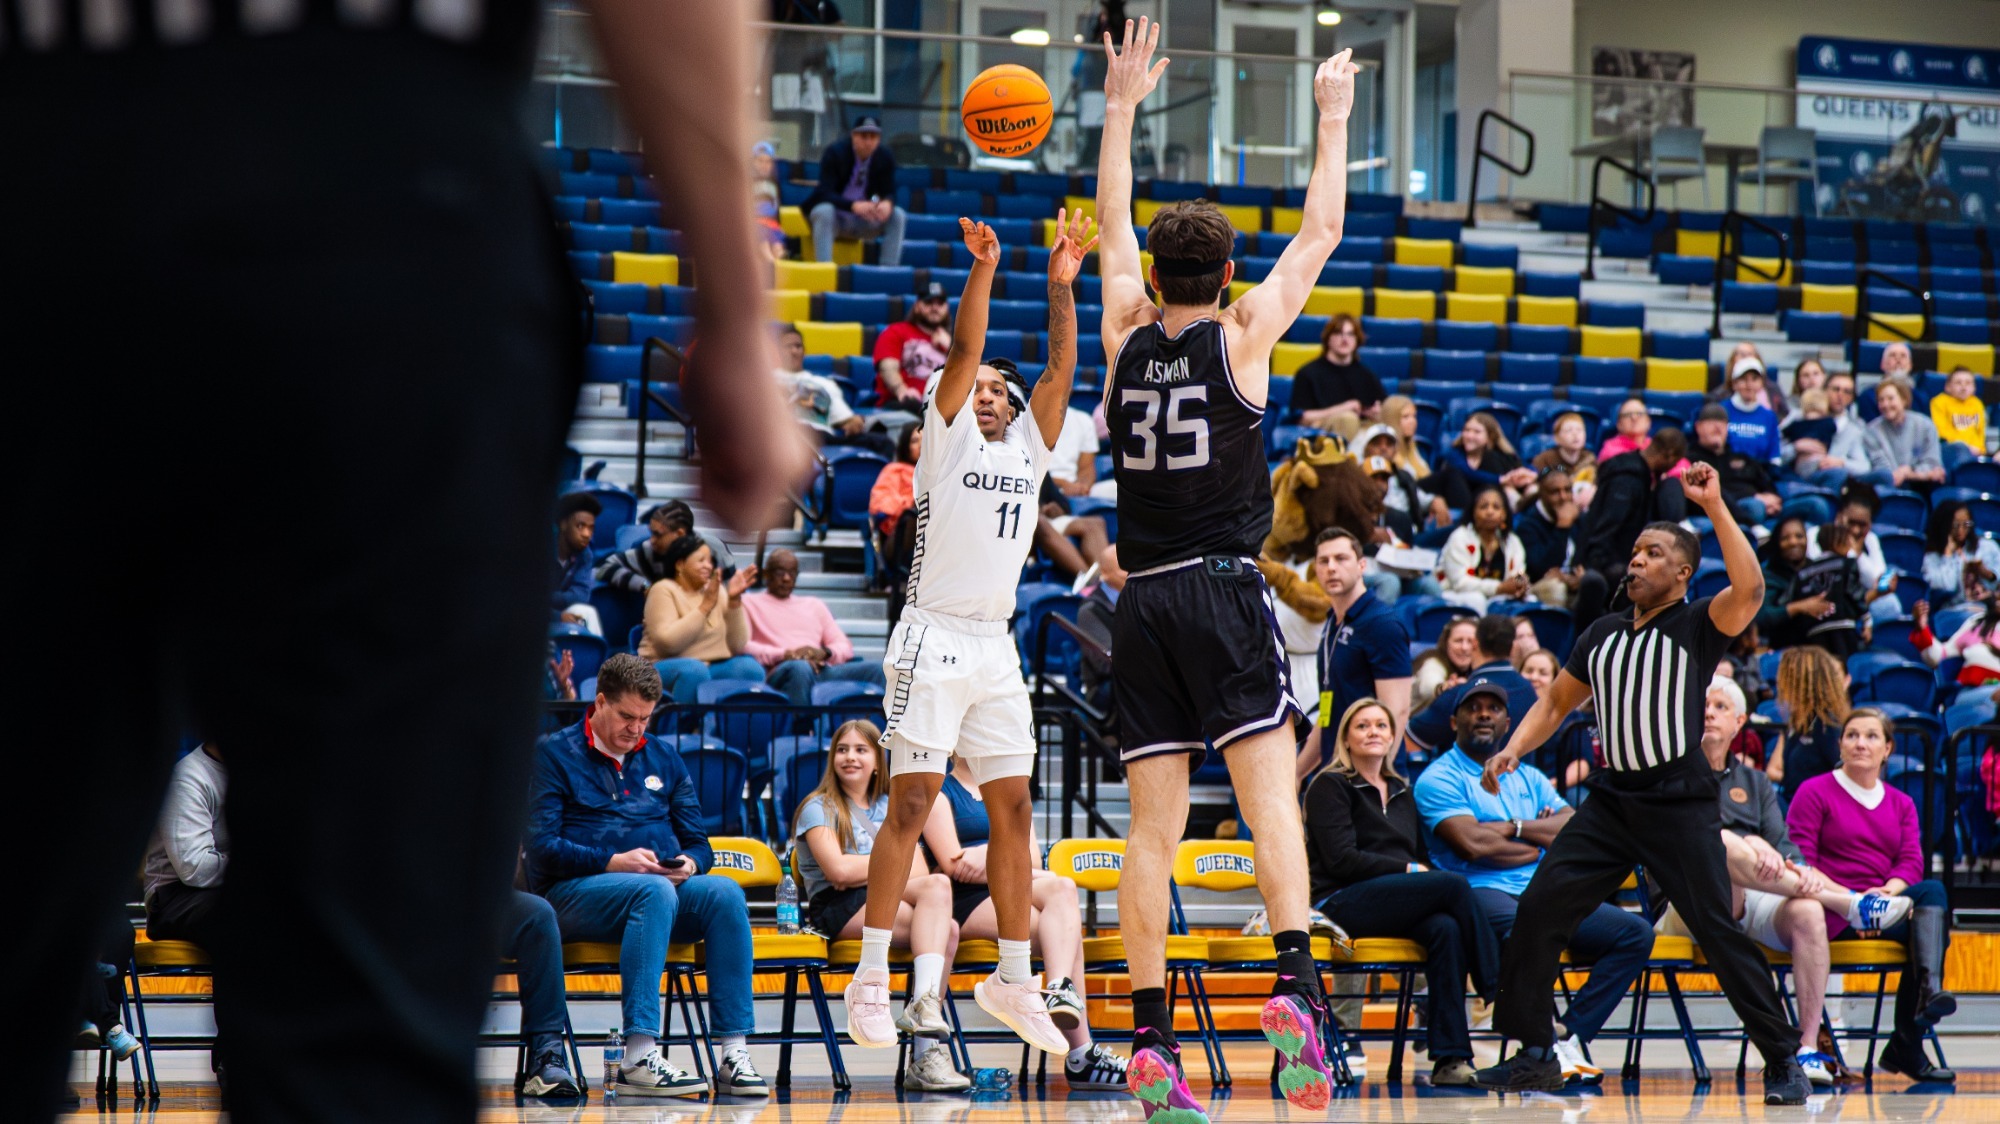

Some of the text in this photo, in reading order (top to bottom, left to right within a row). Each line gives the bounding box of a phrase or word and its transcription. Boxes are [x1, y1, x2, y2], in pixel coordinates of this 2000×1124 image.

[1813, 96, 1910, 120] QUEENS
[975, 116, 1037, 134] Wilson
[1143, 356, 1190, 384] ASMAN
[1121, 384, 1210, 471] 35
[994, 501, 1022, 540] 11
[712, 851, 755, 873] EENS
[1073, 852, 1125, 872] QUEEN
[1196, 854, 1254, 875] QUEENS
